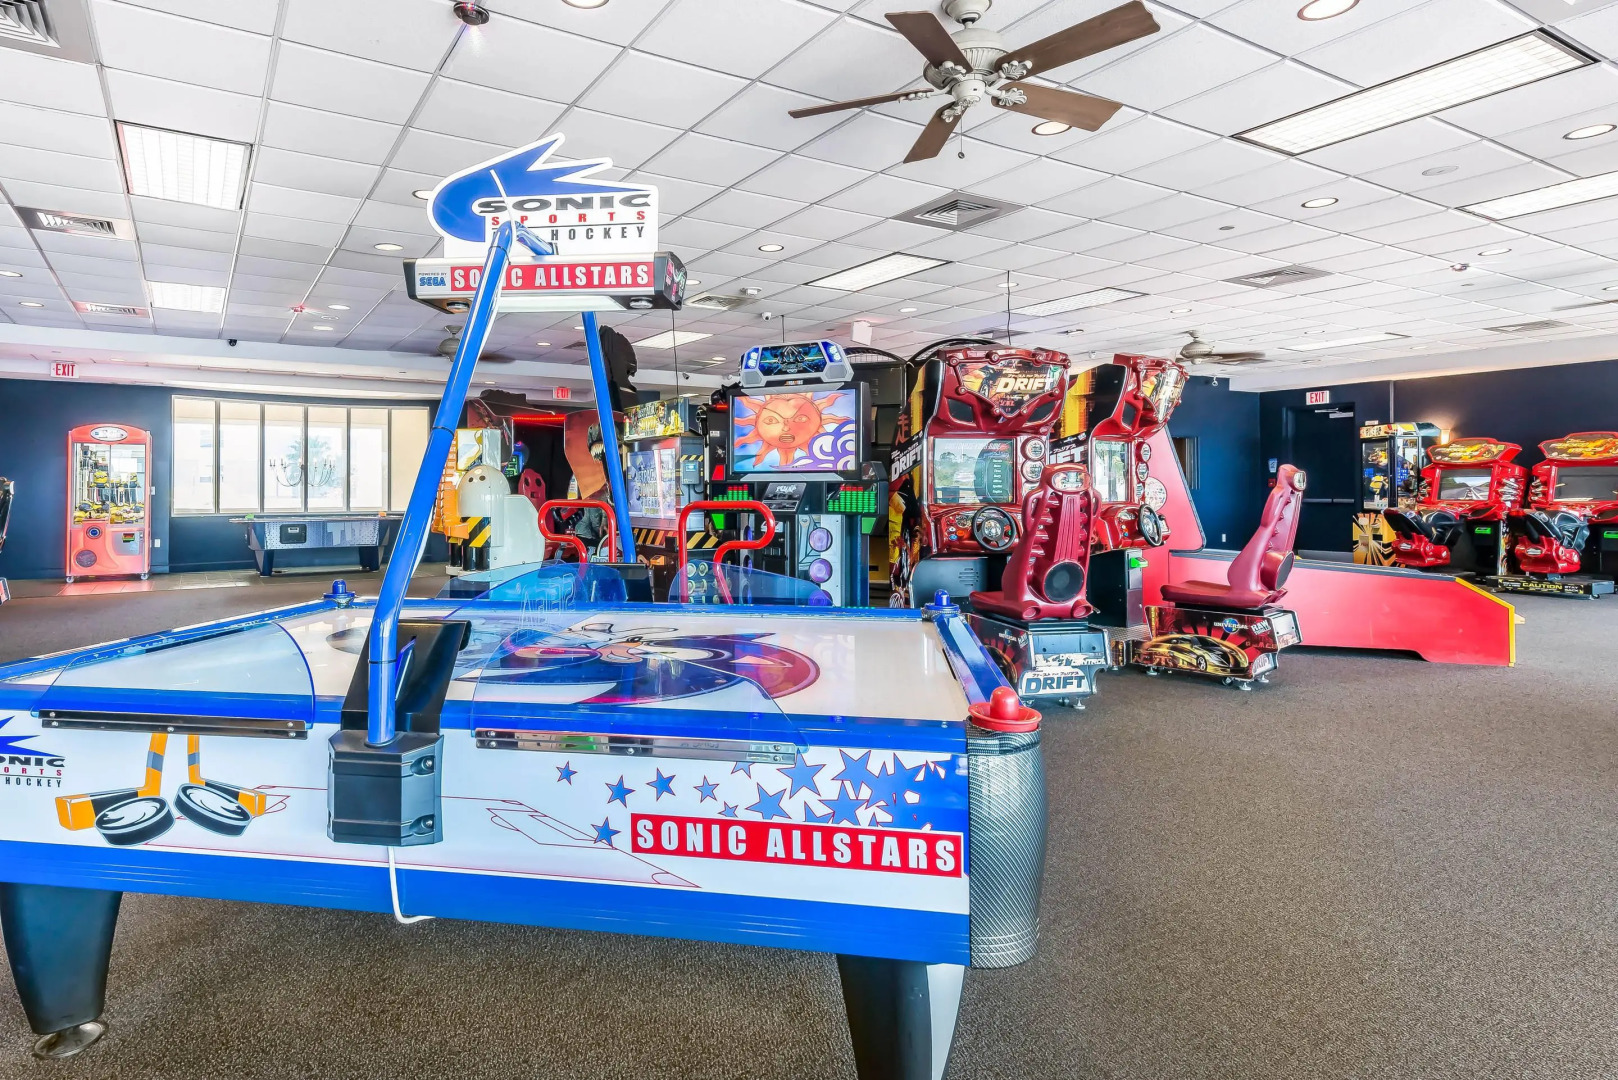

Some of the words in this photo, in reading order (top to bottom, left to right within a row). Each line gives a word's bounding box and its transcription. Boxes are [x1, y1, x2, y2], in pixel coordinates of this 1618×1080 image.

[478, 193, 652, 214] SONIC
[491, 210, 646, 226] SPORTS
[550, 226, 645, 241] HOCKEY
[419, 276, 446, 287] SEGA
[453, 268, 523, 289] SOC
[534, 264, 649, 288] ALLSTARS
[55, 363, 75, 377] EXIT
[996, 376, 1054, 393] DRIFT
[1309, 391, 1325, 404] EXIT
[891, 444, 922, 482] DRIFT
[1522, 582, 1563, 590] CAUTION
[1213, 621, 1249, 630] UNIVERSAL
[1025, 676, 1086, 694] DRIFT
[5, 776, 62, 788] HOCKEY
[636, 819, 747, 856] SONIC
[766, 828, 957, 871] ALLSTARS
